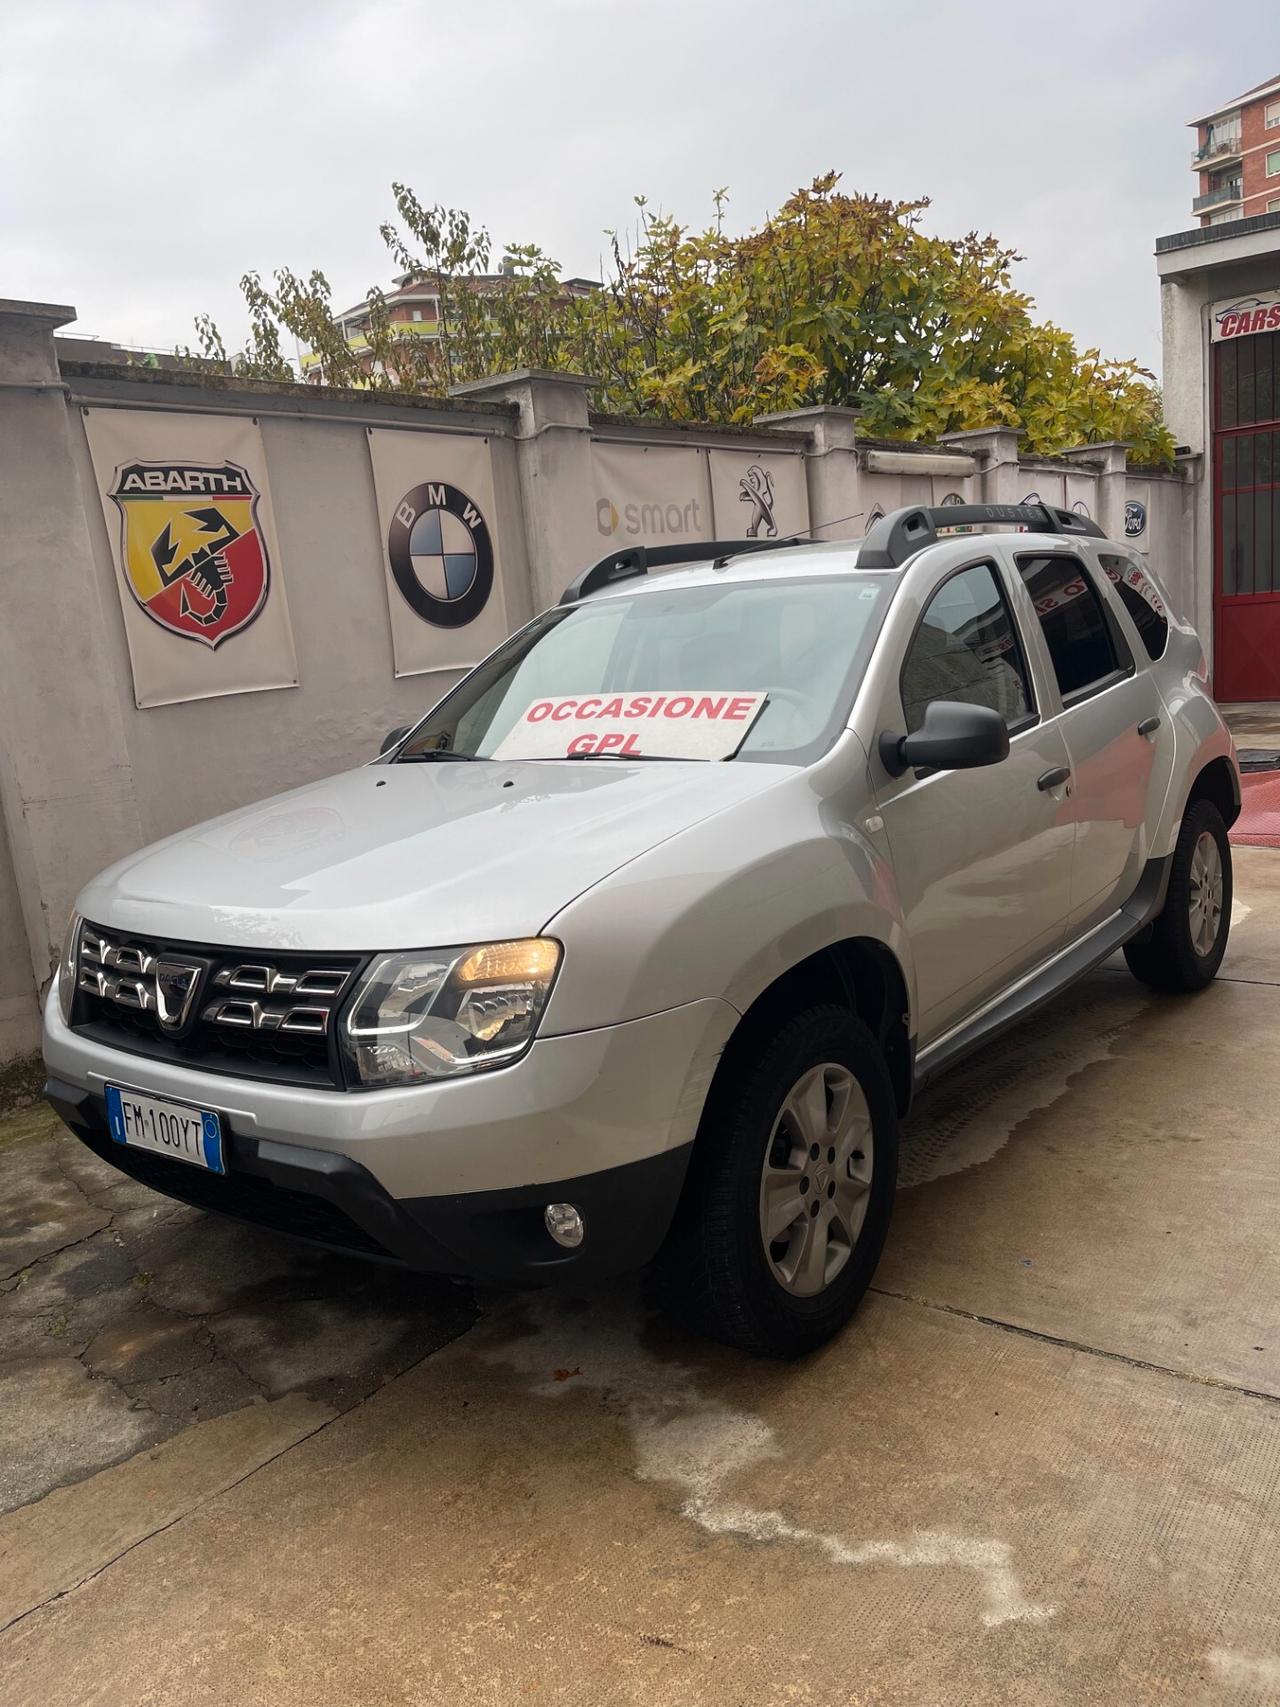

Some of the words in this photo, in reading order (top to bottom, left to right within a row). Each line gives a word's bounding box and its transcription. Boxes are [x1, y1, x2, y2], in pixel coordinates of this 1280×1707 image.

[1221, 306, 1280, 337] CARS
[123, 470, 242, 491] ABARTH
[396, 484, 482, 529] BMW
[625, 498, 702, 535] smart
[526, 697, 757, 723] OCCASIONE
[566, 734, 643, 756] GPL
